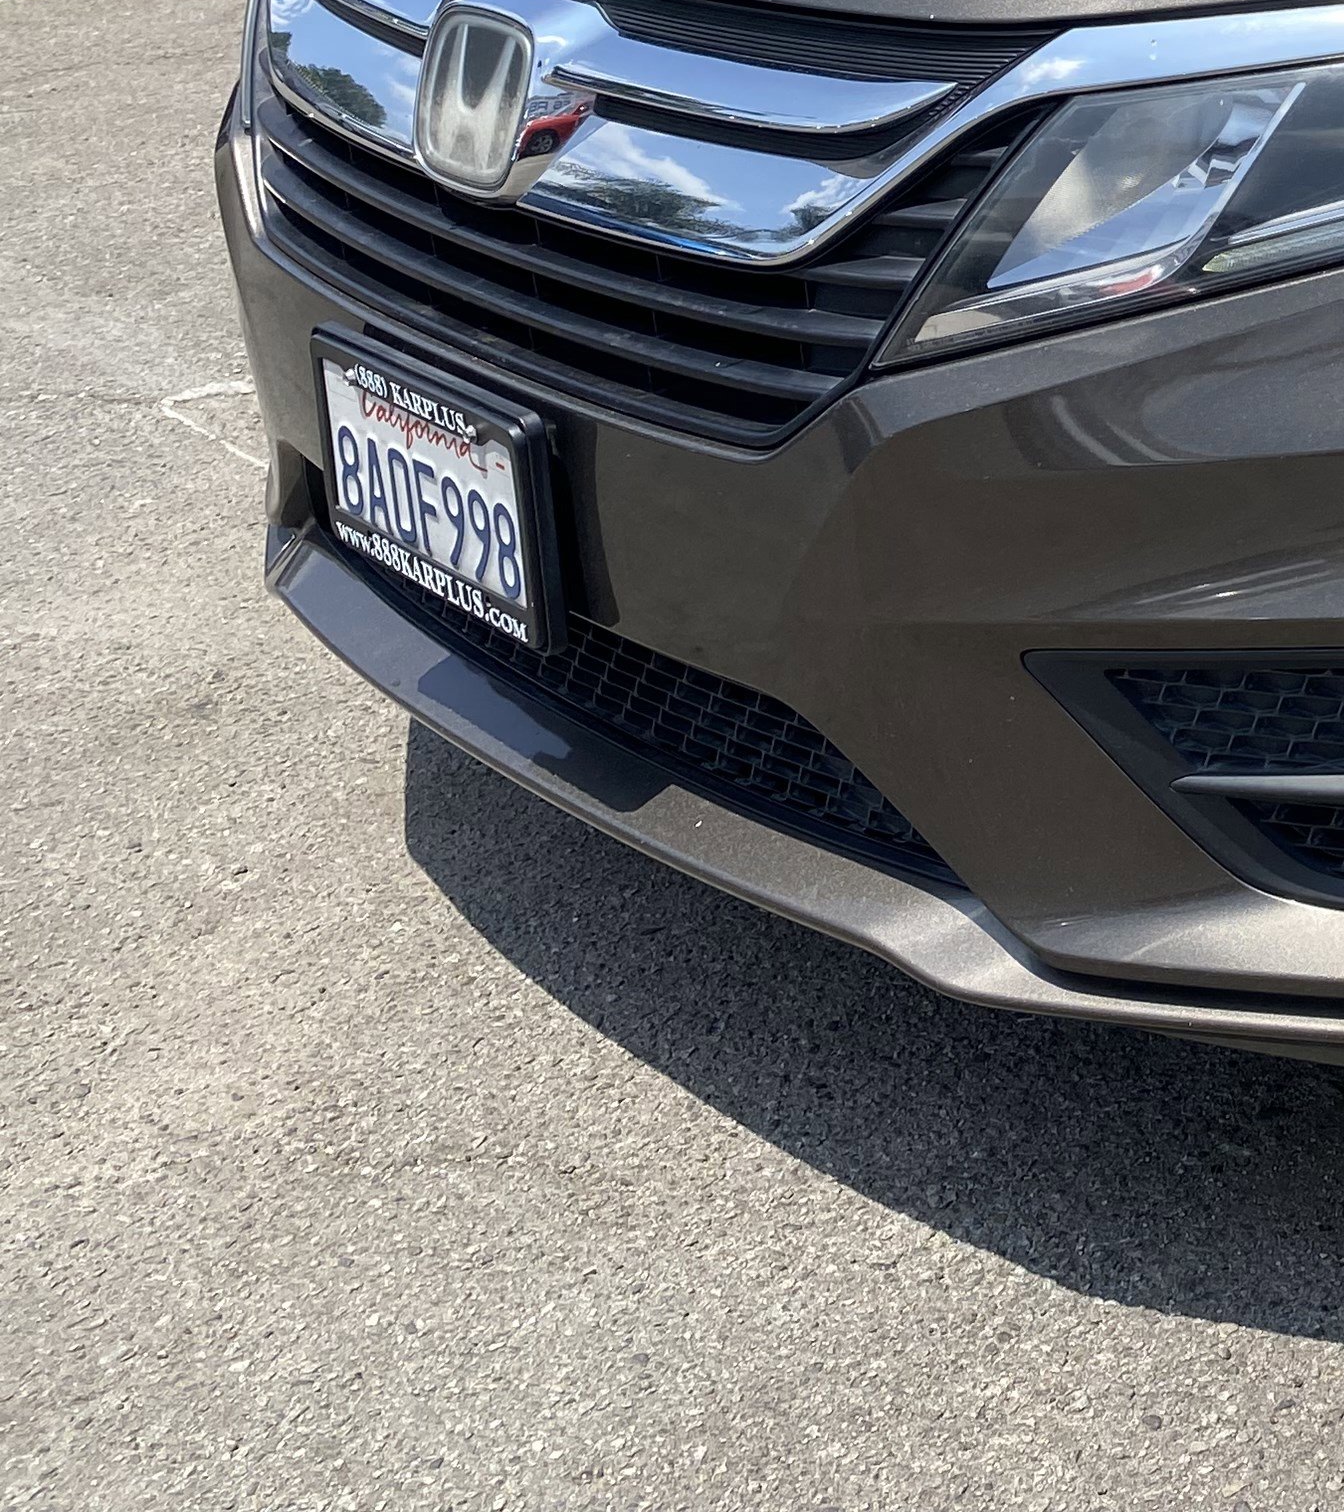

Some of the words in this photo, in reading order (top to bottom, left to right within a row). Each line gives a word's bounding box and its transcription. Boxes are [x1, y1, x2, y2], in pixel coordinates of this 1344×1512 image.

[354, 363, 388, 399] (888)
[389, 381, 466, 435] KARPLUS
[361, 390, 488, 471] California
